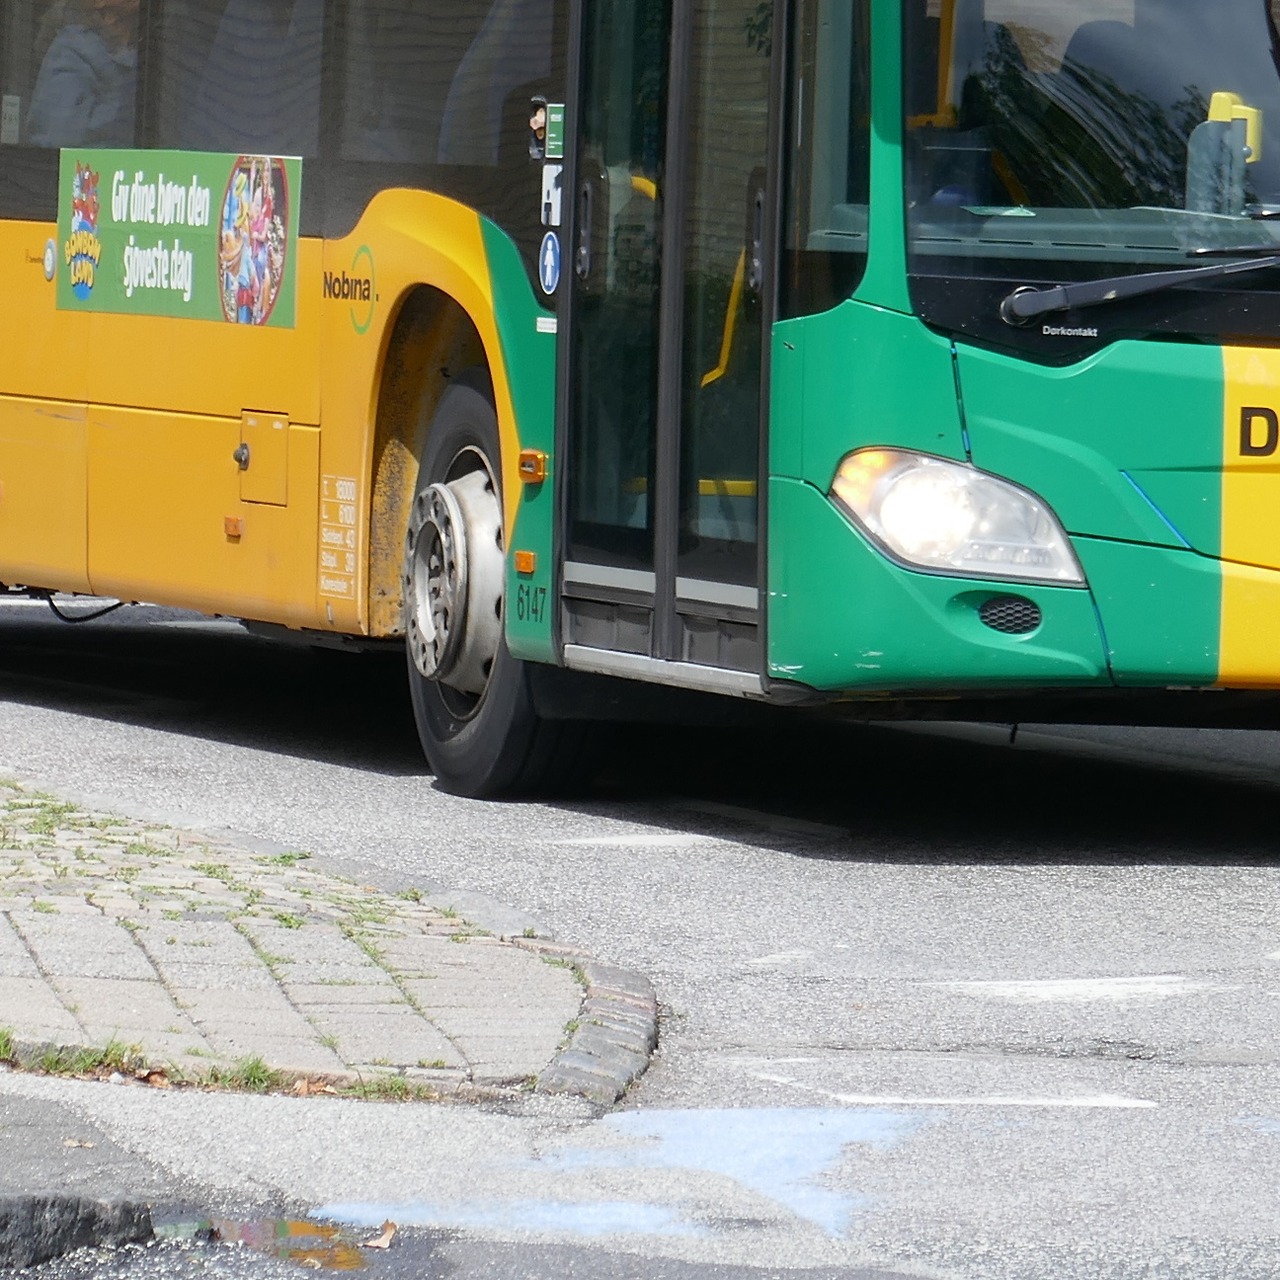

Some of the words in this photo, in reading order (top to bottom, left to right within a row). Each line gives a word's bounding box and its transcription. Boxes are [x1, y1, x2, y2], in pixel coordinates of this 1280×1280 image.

[112, 170, 129, 222] Giv
[130, 170, 156, 223] dine
[157, 173, 186, 226] børn
[187, 175, 210, 226] den
[71, 260, 94, 288] LAND
[123, 235, 169, 297] sjoveste
[170, 239, 192, 302] dag
[1042, 325, 1098, 337] Dørkontakt
[517, 584, 547, 623] 6147
